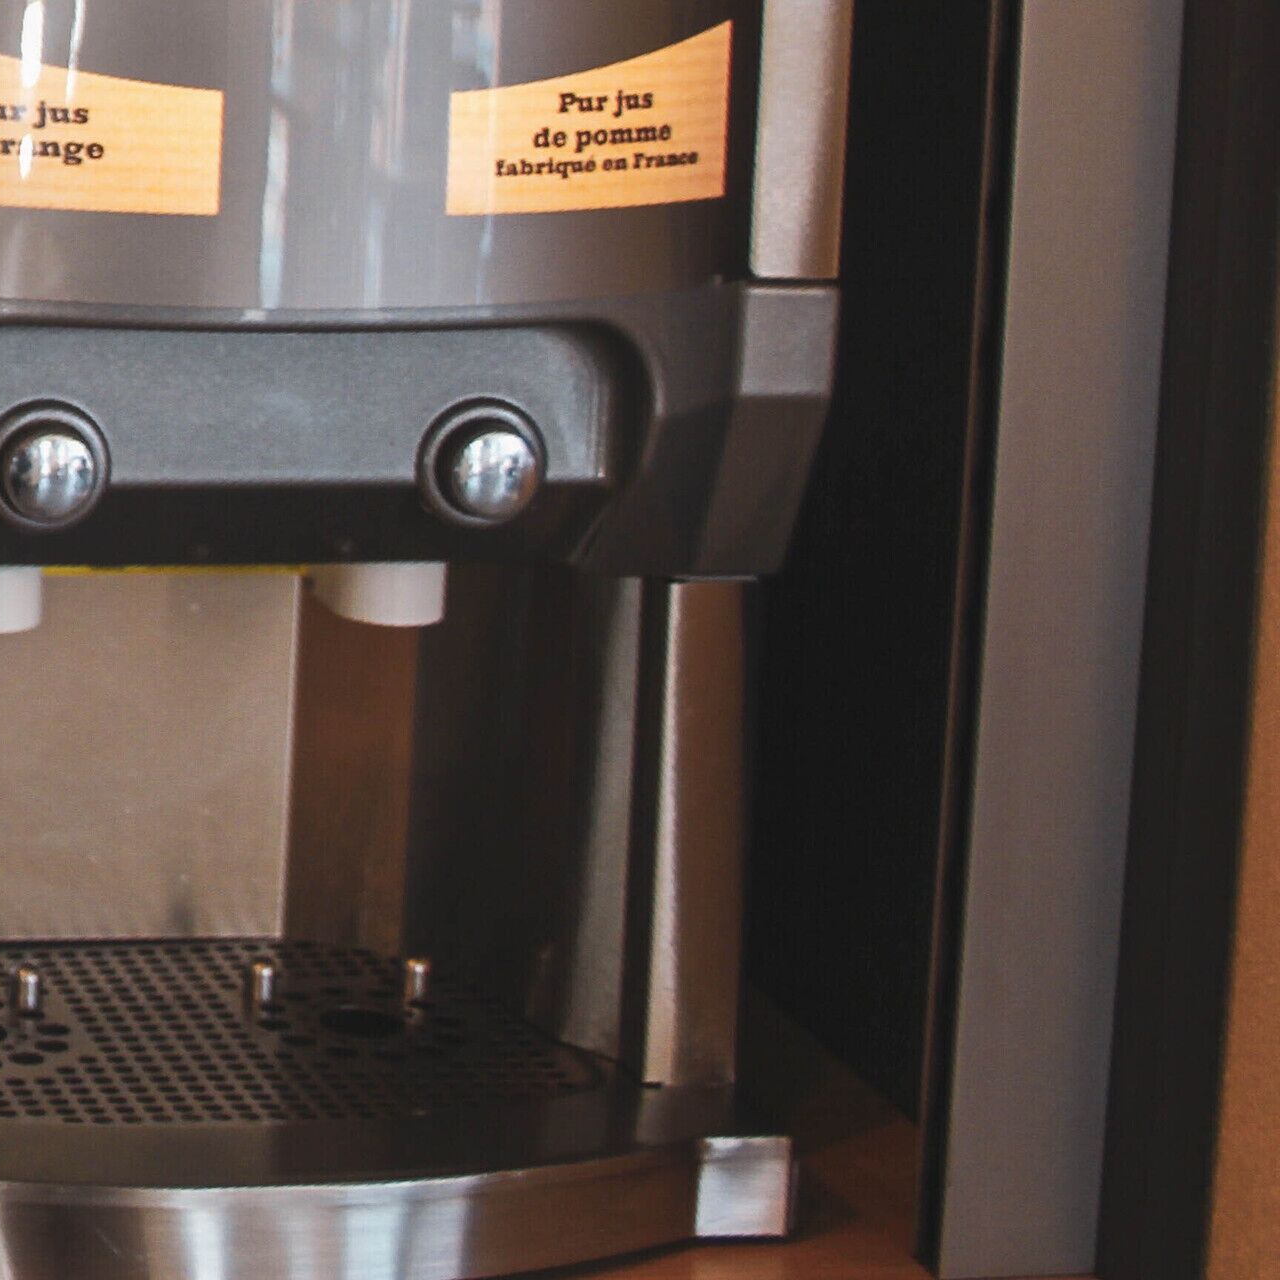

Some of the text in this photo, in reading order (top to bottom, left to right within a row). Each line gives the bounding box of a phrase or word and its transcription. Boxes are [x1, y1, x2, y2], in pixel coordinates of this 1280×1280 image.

[33, 100, 90, 128] jus
[558, 90, 654, 117] Pur jus
[533, 123, 672, 153] de pomme
[602, 157, 628, 171] en
[633, 151, 699, 169] France
